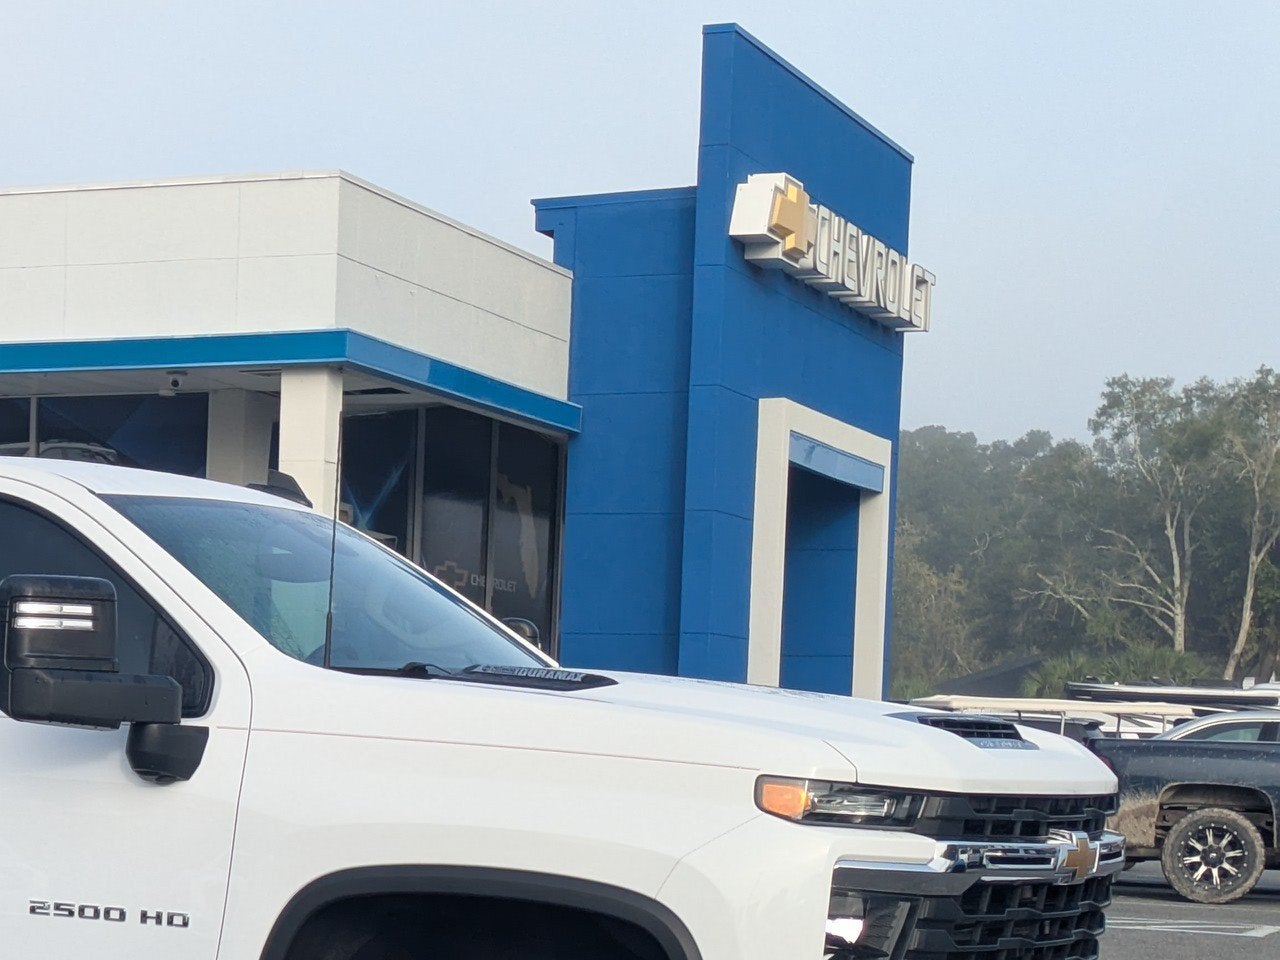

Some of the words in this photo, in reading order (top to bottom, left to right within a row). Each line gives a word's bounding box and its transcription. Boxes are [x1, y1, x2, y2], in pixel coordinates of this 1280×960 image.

[815, 204, 936, 332] CHEVROLET
[471, 574, 516, 592] CHEROLET
[29, 899, 126, 922] 2500
[140, 909, 190, 928] HD
